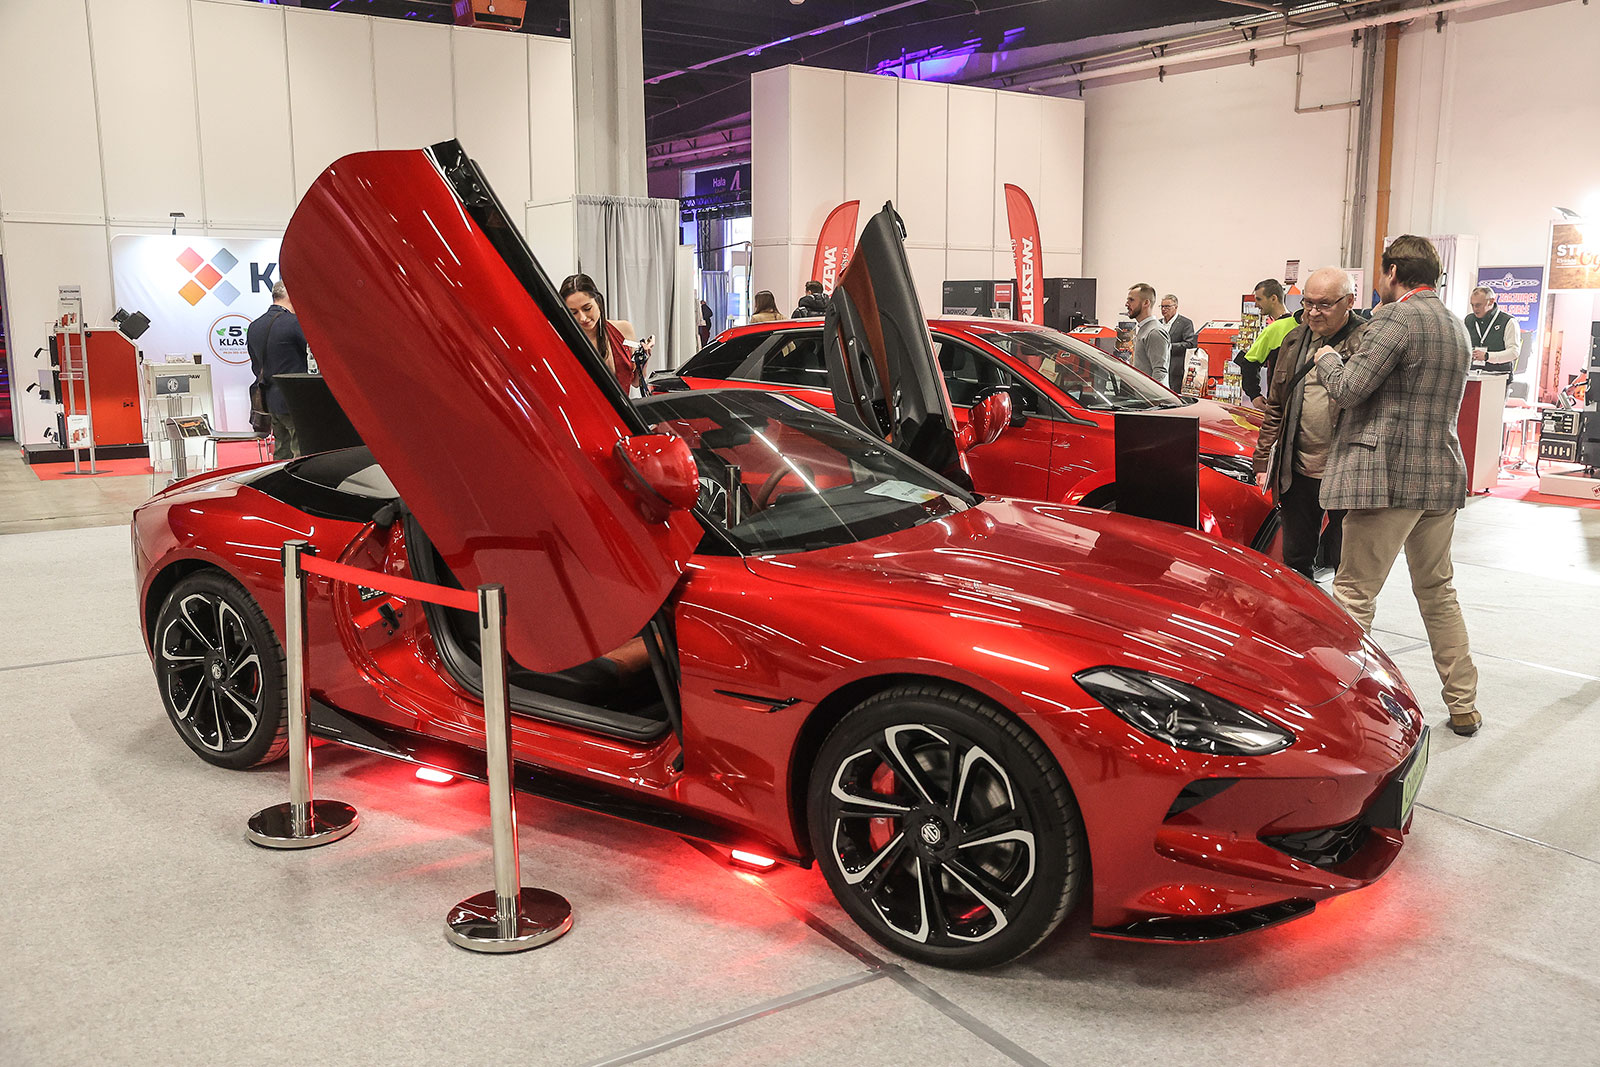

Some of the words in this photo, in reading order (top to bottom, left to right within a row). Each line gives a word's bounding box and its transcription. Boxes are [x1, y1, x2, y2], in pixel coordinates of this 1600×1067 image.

[712, 177, 727, 188] Hala
[229, 326, 242, 337] 5
[922, 824, 939, 843] MG
